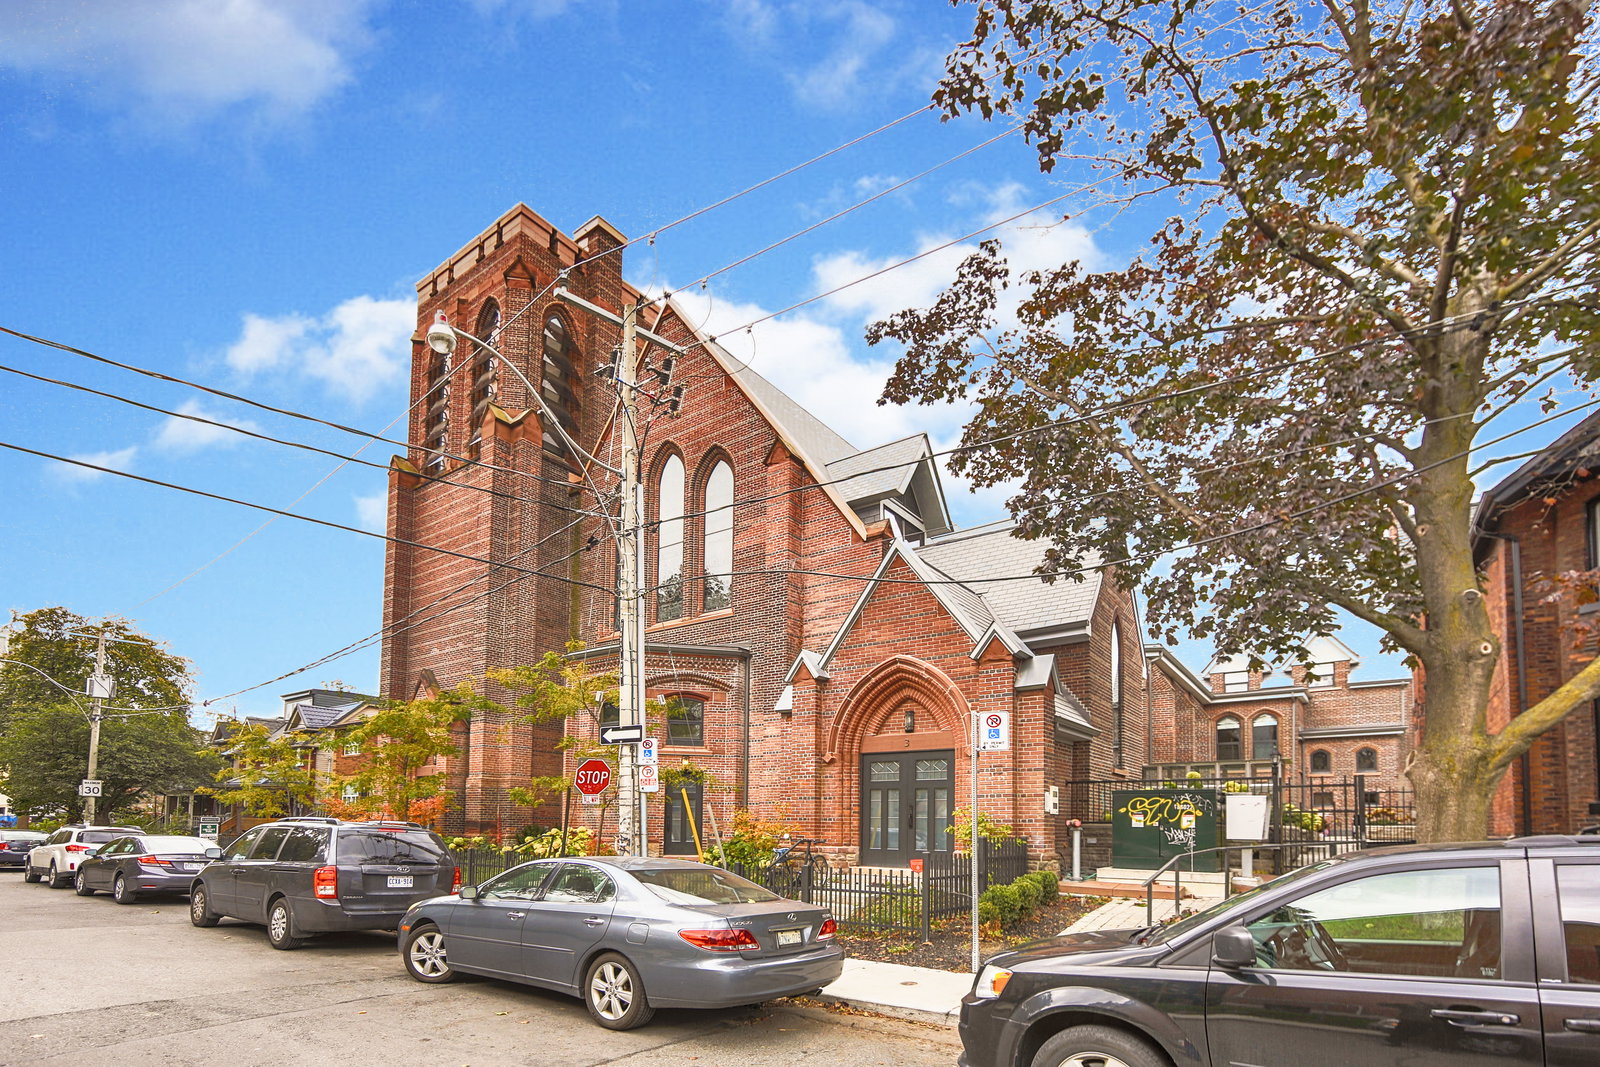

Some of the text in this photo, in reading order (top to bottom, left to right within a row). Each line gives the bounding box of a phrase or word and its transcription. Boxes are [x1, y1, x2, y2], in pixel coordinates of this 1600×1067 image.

[904, 739, 910, 748] 3
[577, 770, 609, 785] STOP
[84, 786, 100, 795] 30
